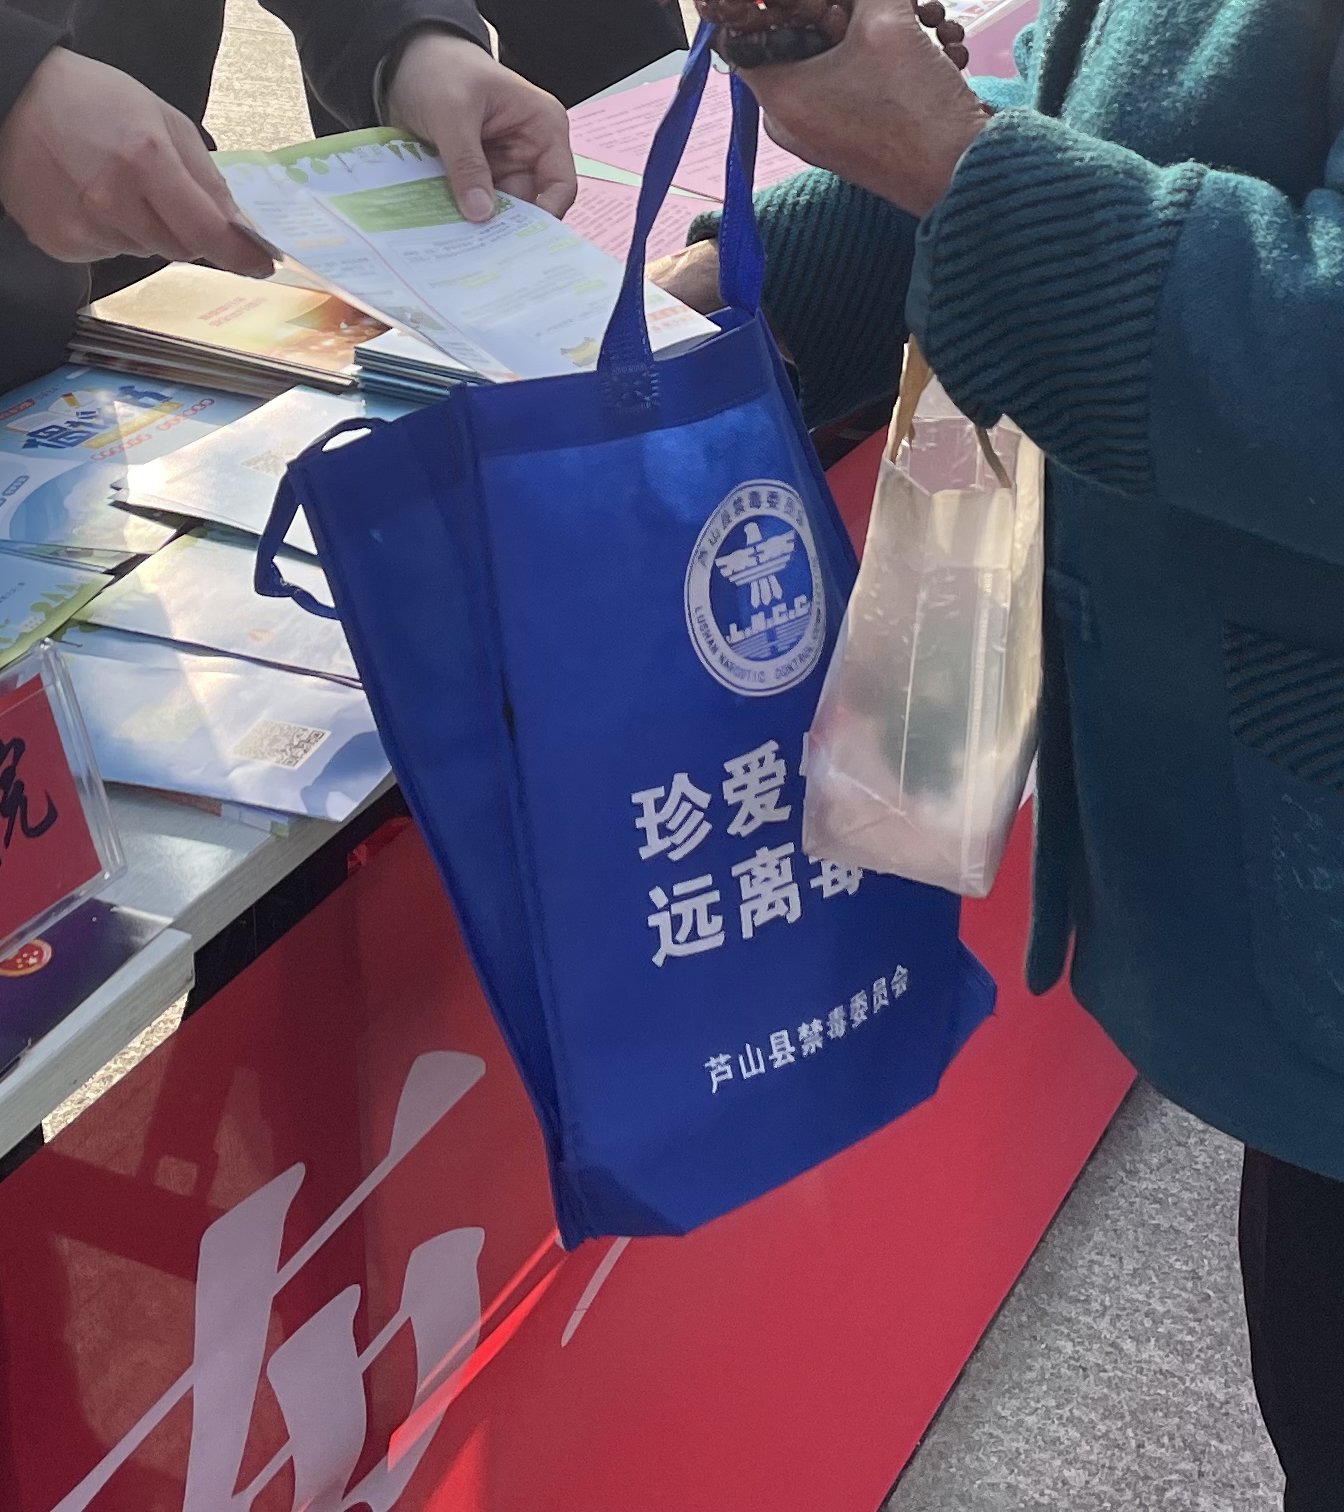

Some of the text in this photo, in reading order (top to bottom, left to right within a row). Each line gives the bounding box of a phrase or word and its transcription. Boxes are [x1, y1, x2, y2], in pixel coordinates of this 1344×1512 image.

[630, 731, 808, 863] 珍爱
[704, 963, 910, 1094] 芦山县禁毒委员会
